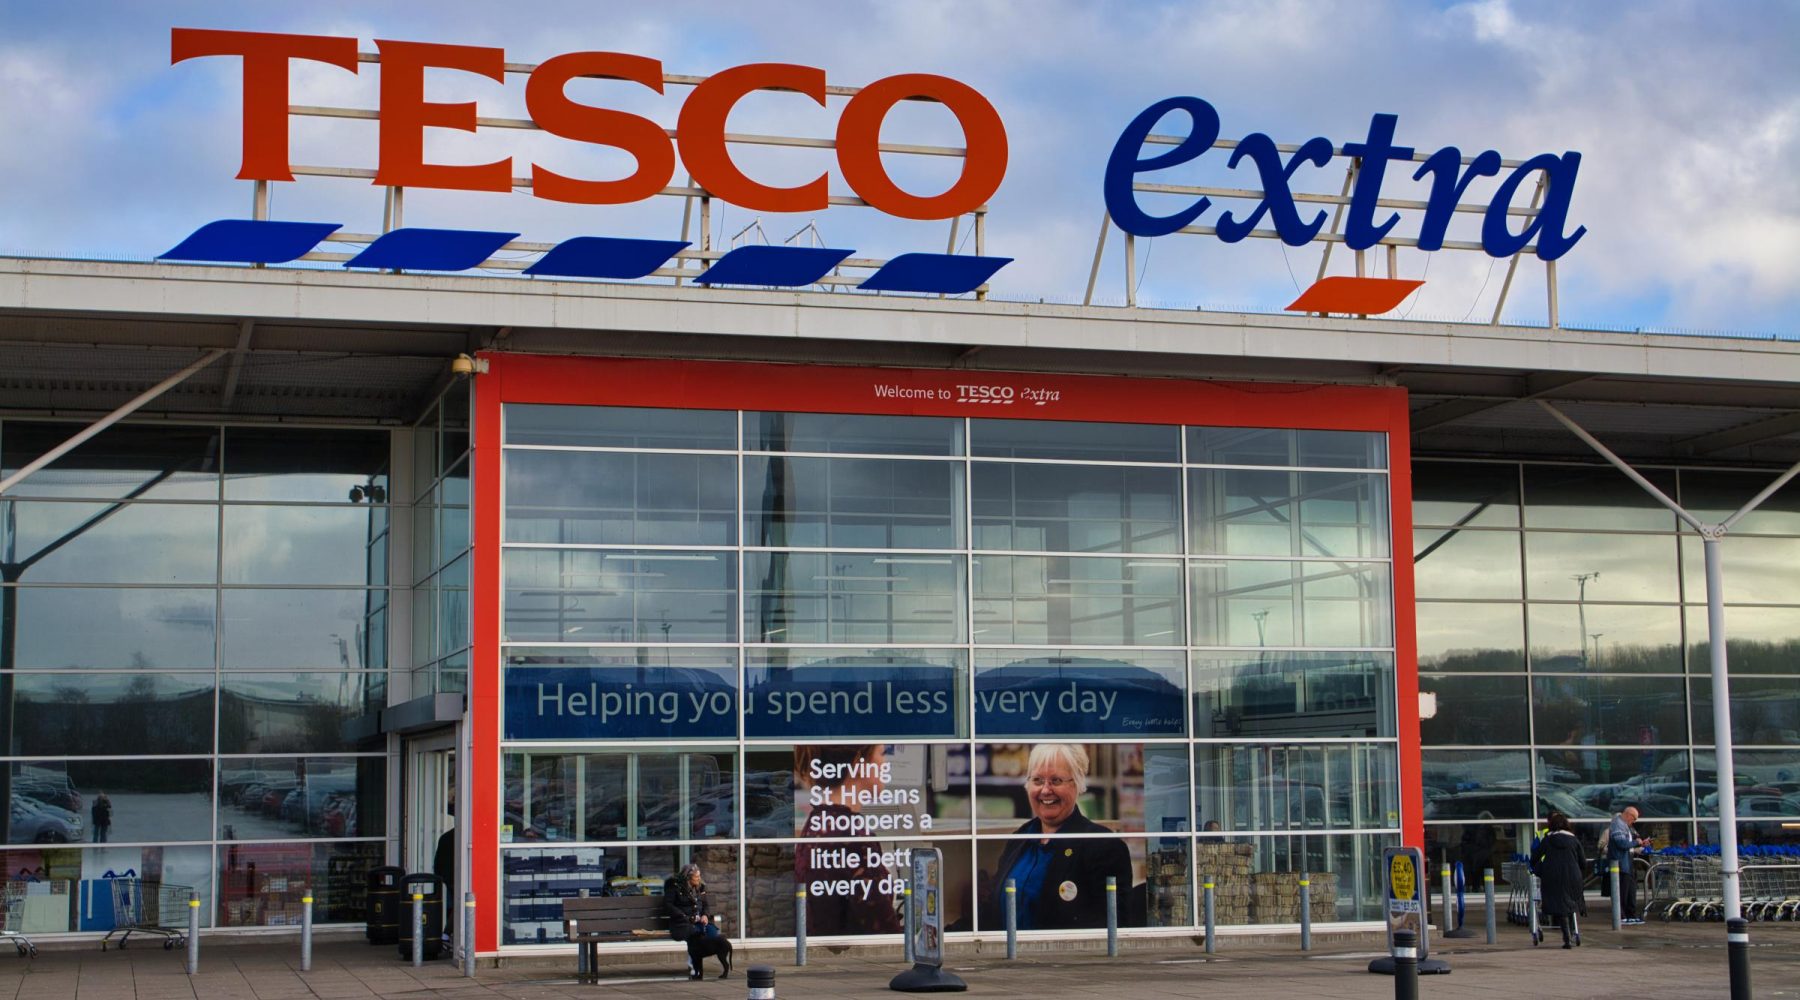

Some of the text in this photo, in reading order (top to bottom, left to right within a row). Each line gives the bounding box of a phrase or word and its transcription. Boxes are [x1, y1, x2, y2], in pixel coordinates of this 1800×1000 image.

[171, 27, 1587, 261] TESCO extra
[874, 384, 935, 399] Welcome
[938, 388, 951, 400] to
[956, 385, 1014, 399] TESCO
[537, 681, 1118, 724] Helping you spend less very day
[809, 757, 891, 783] Serving
[809, 784, 920, 806] St Helens
[809, 811, 933, 836] shoppers a
[810, 847, 912, 869] little bett
[810, 879, 873, 900] every
[878, 874, 908, 895] da
